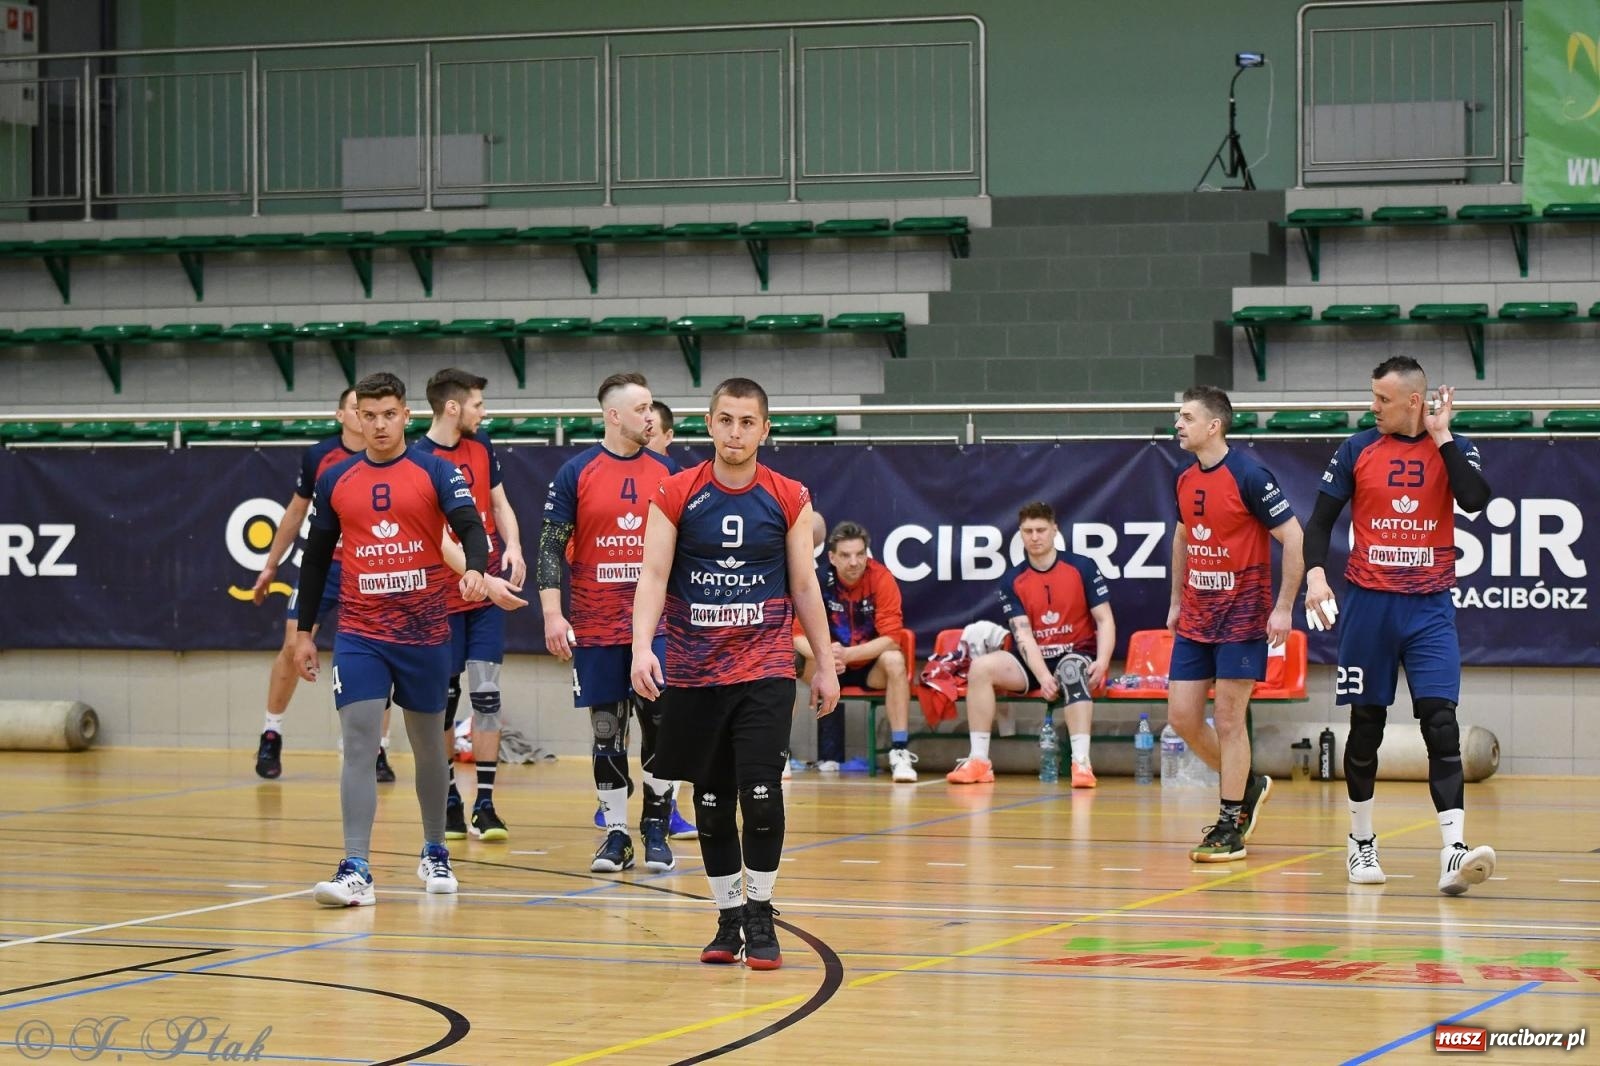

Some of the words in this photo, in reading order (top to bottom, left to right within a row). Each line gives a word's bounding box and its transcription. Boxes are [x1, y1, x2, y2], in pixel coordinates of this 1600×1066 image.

[1388, 459, 1425, 488] 23
[371, 483, 392, 512] 8
[620, 477, 638, 504] 4
[1193, 489, 1206, 517] 3
[721, 514, 744, 548] 9
[1370, 518, 1439, 532] KATOLIK
[595, 535, 645, 548] KATOL
[1381, 532, 1427, 541] GROUP
[0, 523, 78, 577] RZ
[355, 540, 425, 558] KATOLIK
[608, 549, 643, 557] GROU
[1186, 543, 1230, 558] ATOLIK
[368, 556, 414, 567] GROUP
[1336, 666, 1365, 695] 23
